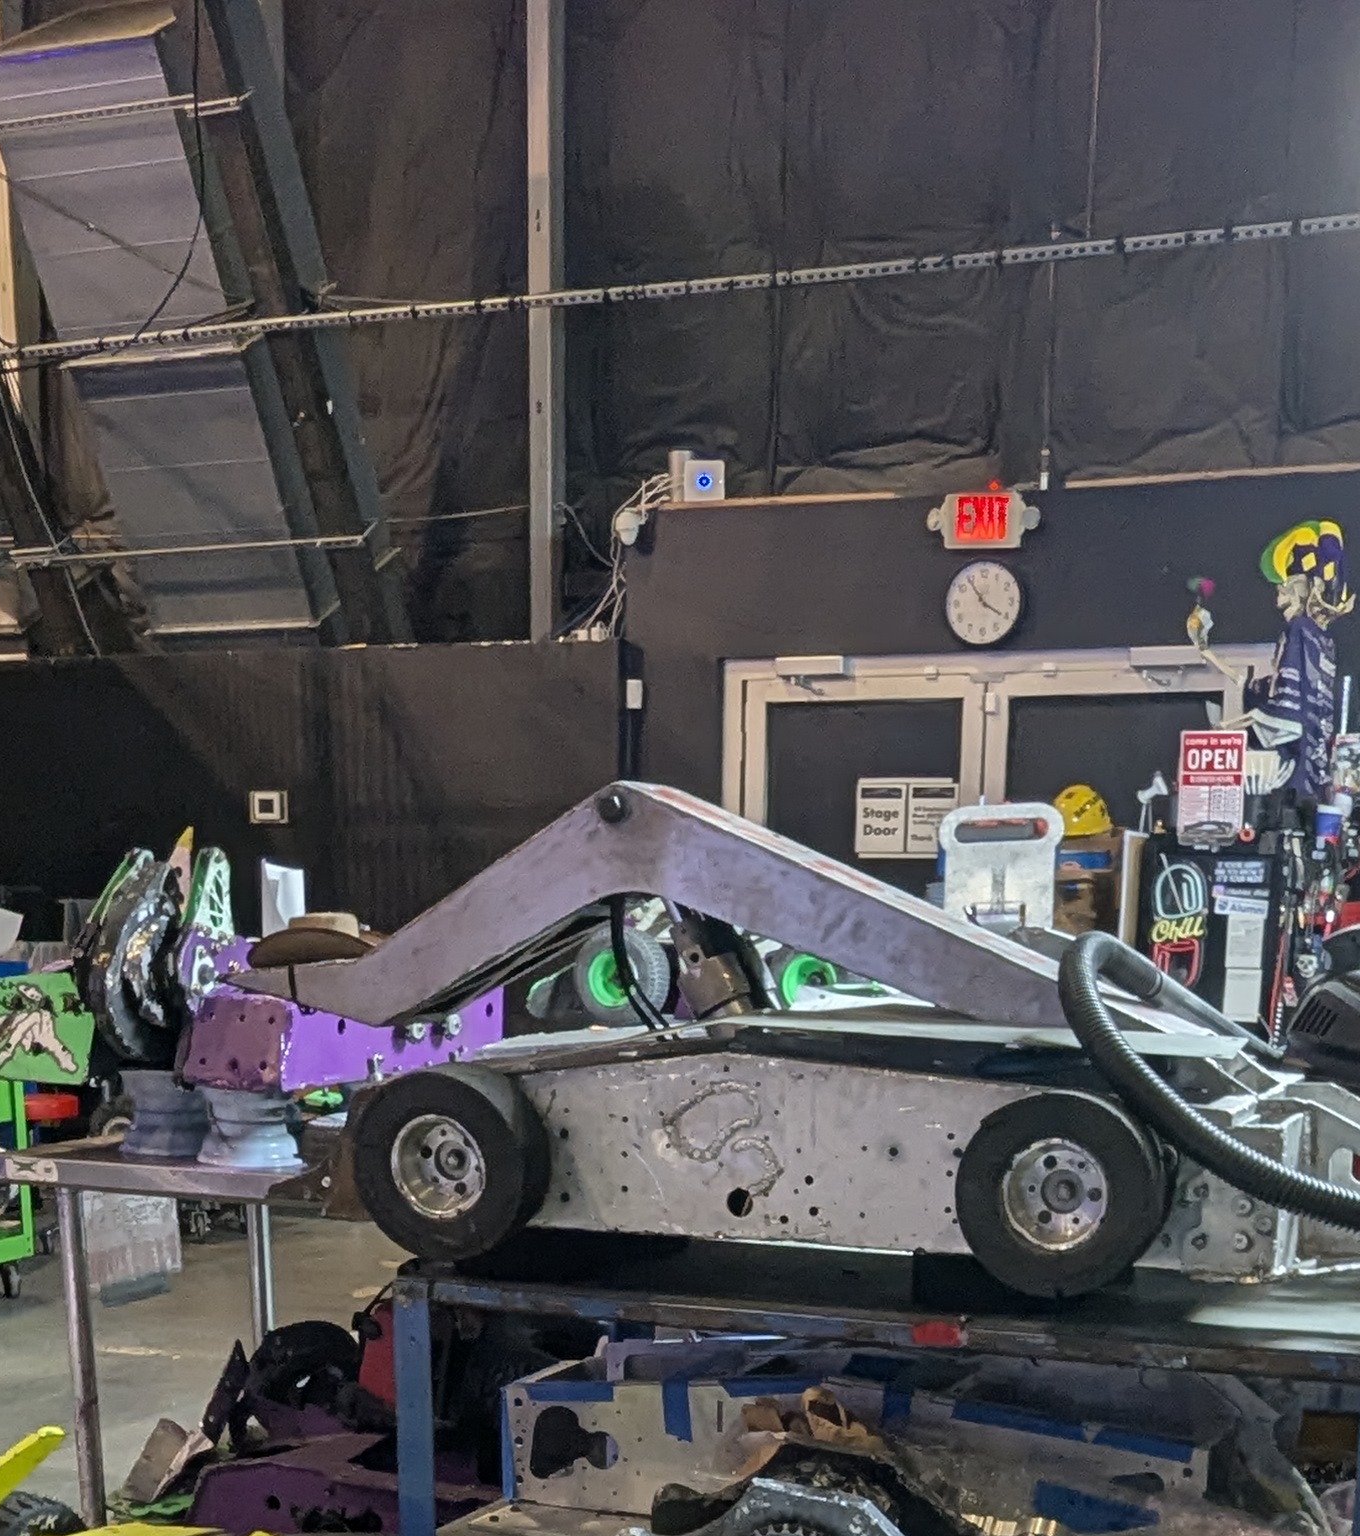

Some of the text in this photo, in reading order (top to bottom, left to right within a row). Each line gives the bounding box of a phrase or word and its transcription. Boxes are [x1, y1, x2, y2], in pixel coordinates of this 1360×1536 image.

[956, 496, 1011, 540] EXIT
[1210, 737, 1219, 745] in
[1187, 748, 1239, 770] OPEN
[862, 806, 899, 821] Stage
[862, 824, 899, 836] Door
[1151, 916, 1204, 944] Chill
